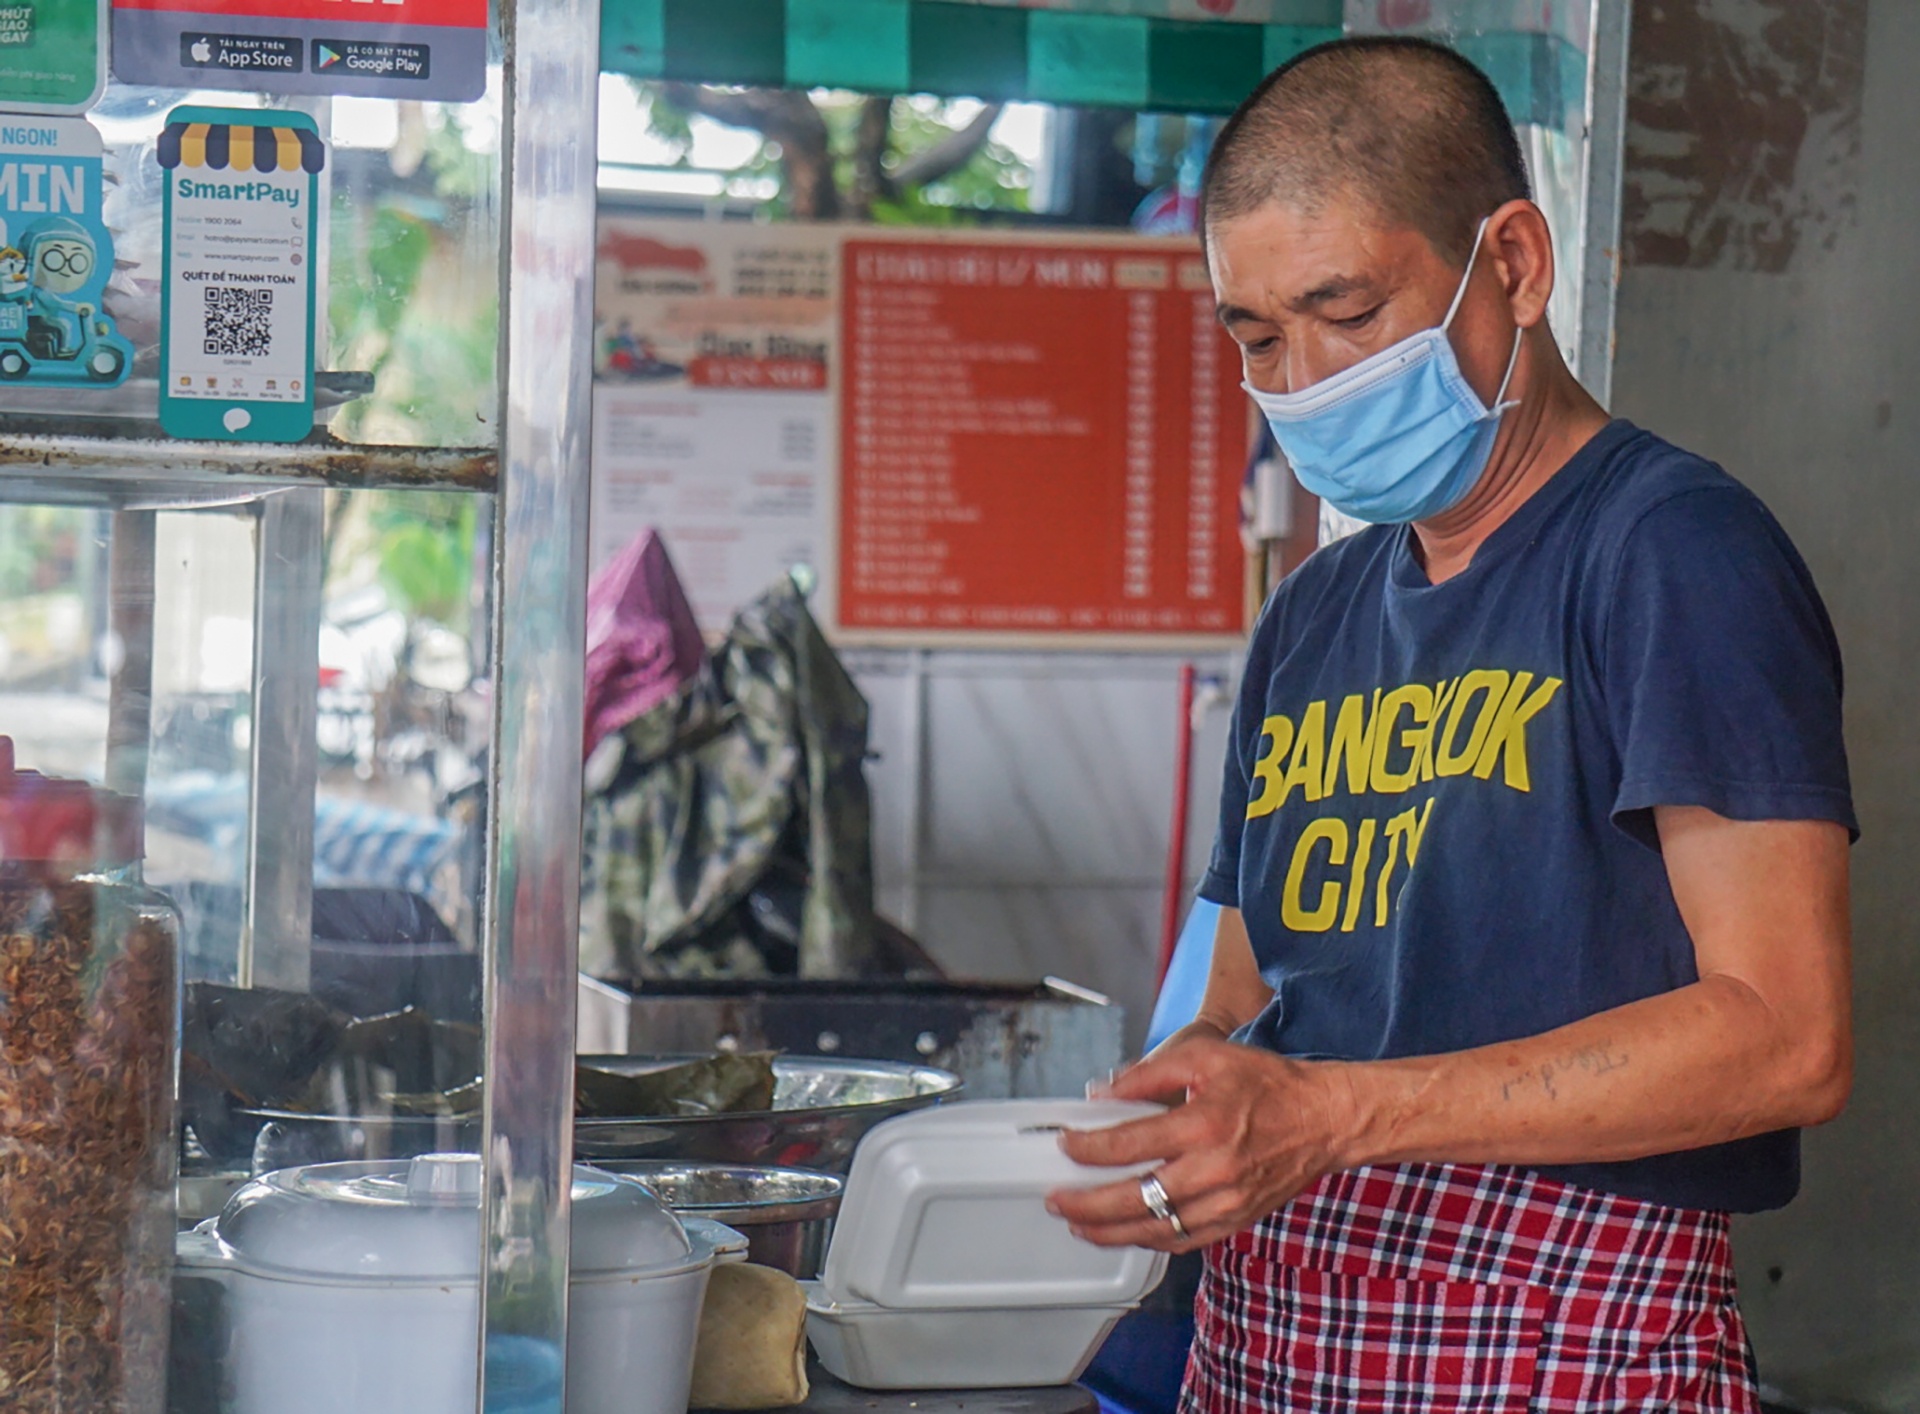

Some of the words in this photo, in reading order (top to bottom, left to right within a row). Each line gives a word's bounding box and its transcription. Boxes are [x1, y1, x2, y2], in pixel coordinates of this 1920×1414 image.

[235, 40, 260, 49] NGAY
[262, 41, 286, 50] TRÊN
[396, 48, 419, 57] TRÊN
[218, 48, 250, 67] App
[252, 50, 293, 67] Store
[346, 54, 394, 74] Google
[396, 57, 422, 75] Play
[2, 127, 57, 147] NGON!
[178, 178, 299, 208] SmartPay
[182, 270, 210, 281] QUÉT
[228, 273, 265, 283] THANH
[266, 274, 296, 284] TOÁN
[1246, 669, 1563, 820] BANGKOK
[1281, 797, 1435, 933] CITY
